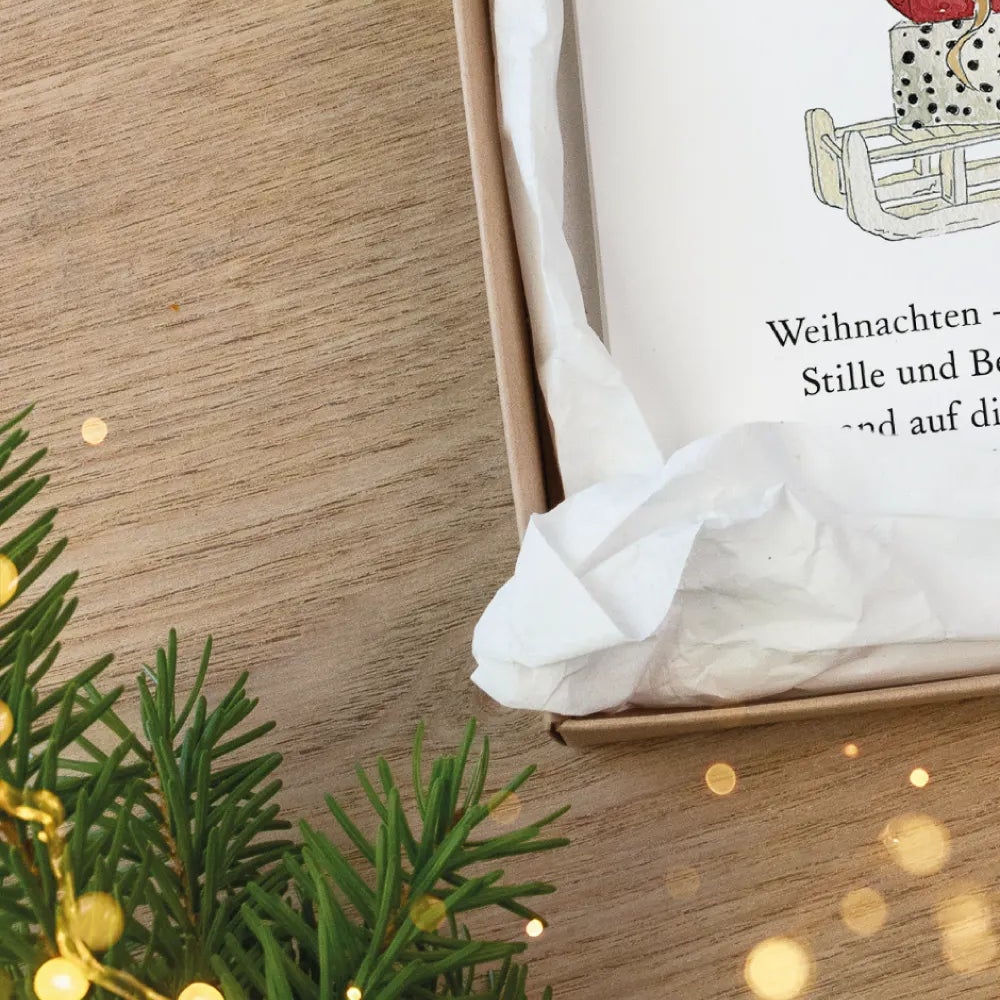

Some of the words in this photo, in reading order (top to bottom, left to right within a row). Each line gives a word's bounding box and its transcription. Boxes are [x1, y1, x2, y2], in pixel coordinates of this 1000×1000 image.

[765, 303, 982, 348] Weihnachten
[802, 361, 886, 397] Stille
[896, 349, 959, 385] und
[840, 407, 897, 437] nd
[908, 399, 962, 436] auf
